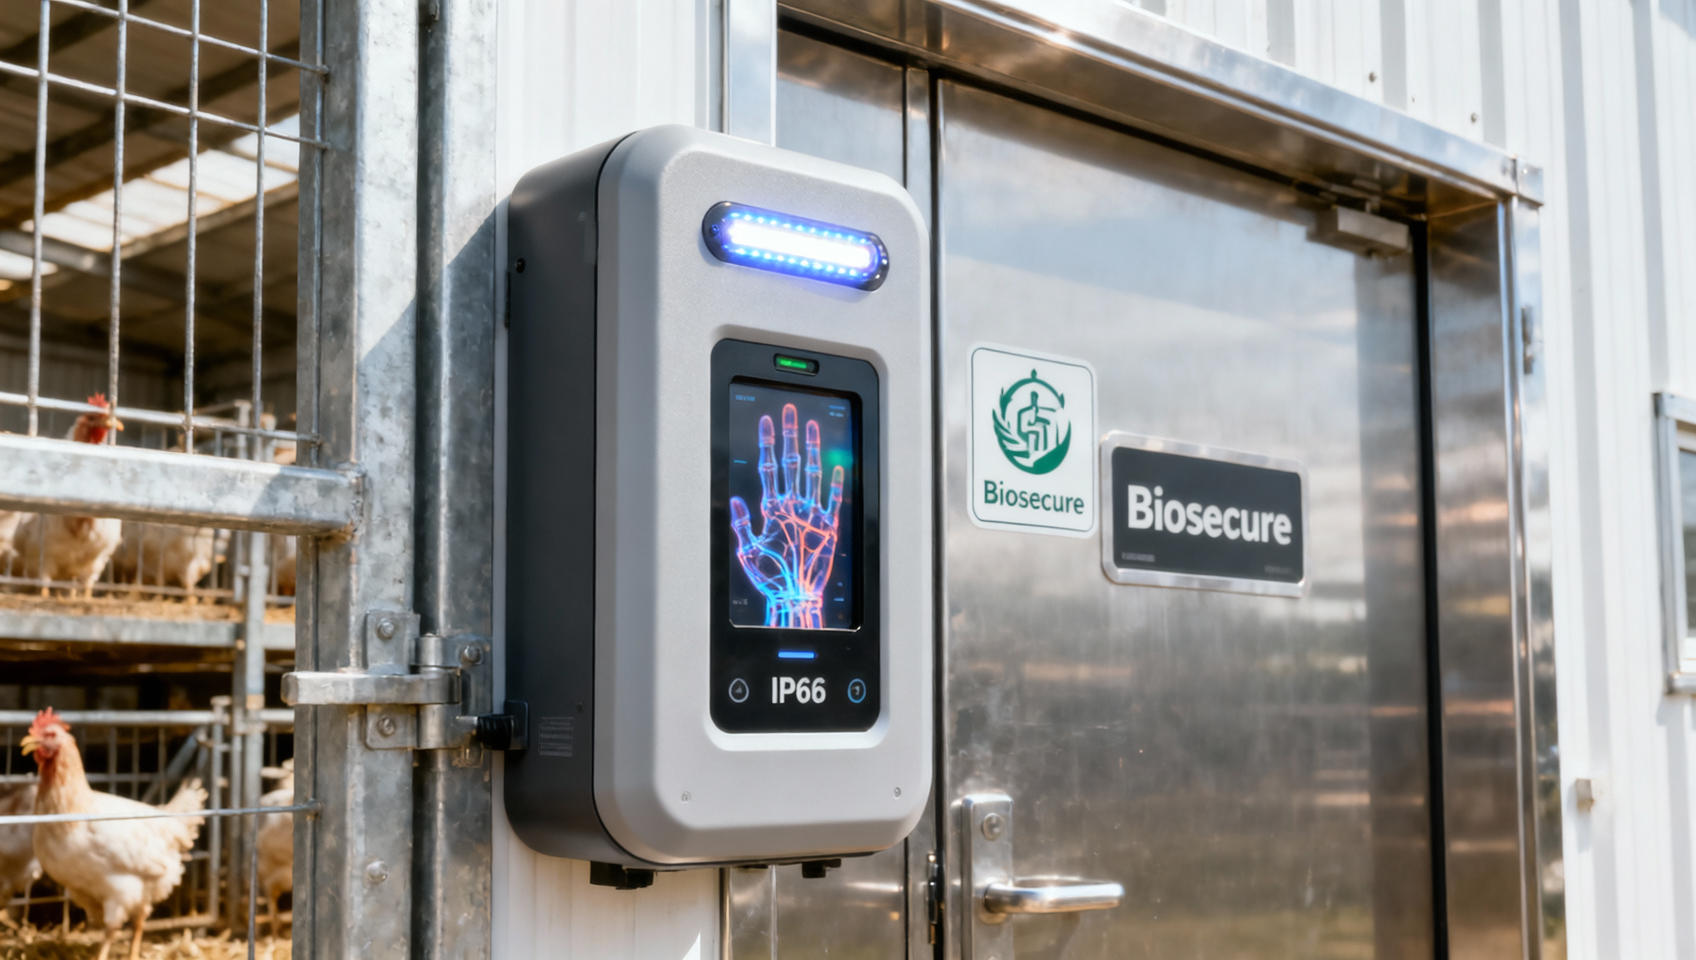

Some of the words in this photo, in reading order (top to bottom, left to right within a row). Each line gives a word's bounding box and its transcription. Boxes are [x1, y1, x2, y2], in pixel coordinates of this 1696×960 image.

[983, 479, 1085, 515] Biosecure
[1127, 483, 1293, 546] Biosecure
[771, 676, 827, 704] IP66
